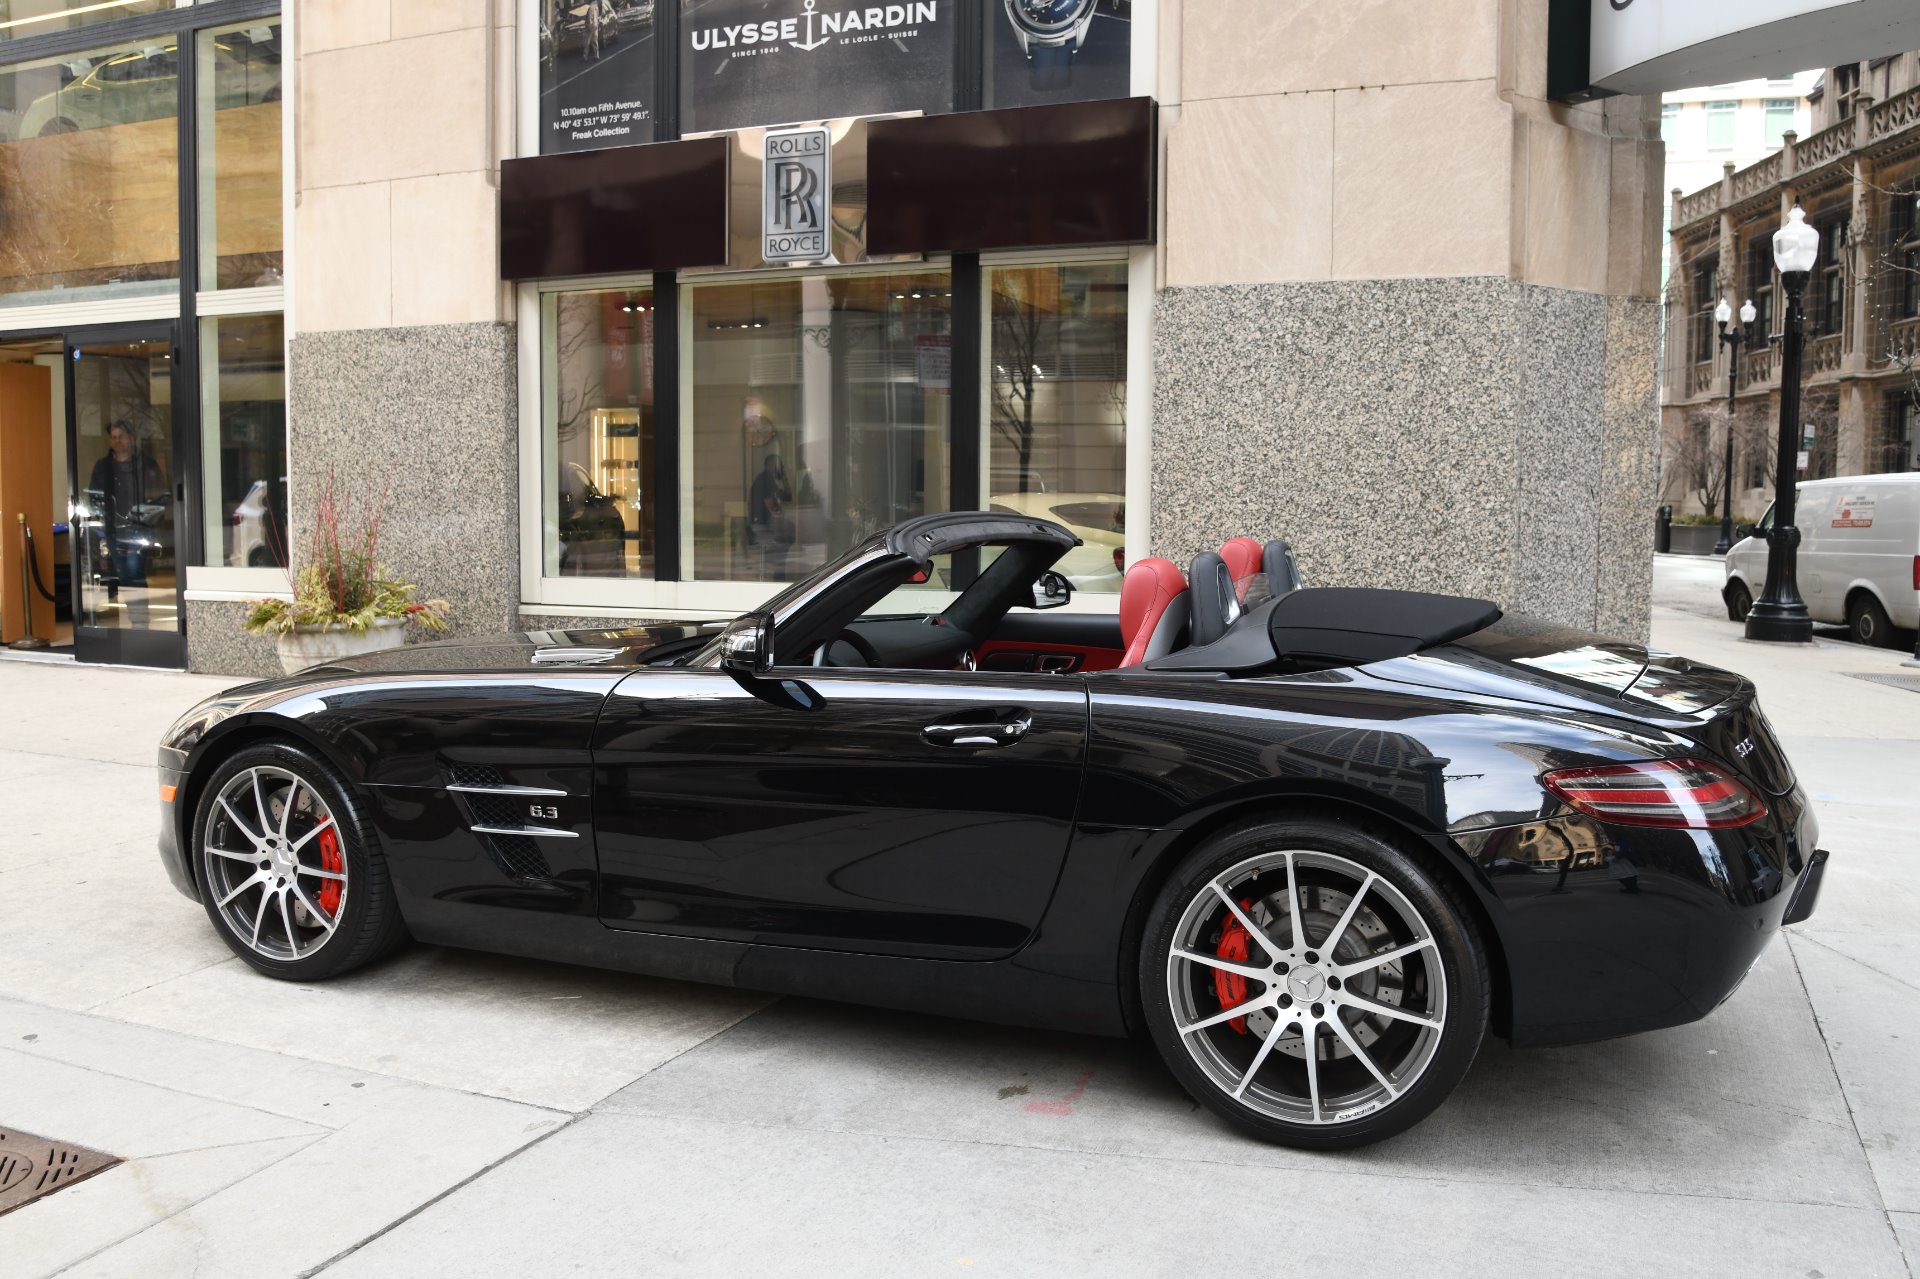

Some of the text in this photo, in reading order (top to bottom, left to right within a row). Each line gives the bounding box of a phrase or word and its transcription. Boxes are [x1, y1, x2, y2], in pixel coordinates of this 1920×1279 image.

[691, 0, 937, 51] ULYSSE NARDIN
[852, 34, 878, 43] LOCLE
[888, 29, 918, 39] SUISSE
[731, 46, 780, 58] SINCE 1846
[561, 100, 642, 117] 10.10am on Fifth Avenue.
[553, 121, 560, 130] N
[599, 116, 608, 124] W
[572, 126, 630, 140] Freak Collection
[770, 136, 821, 155] ROLLS
[773, 161, 818, 230] RR
[769, 236, 820, 253] ROYCE
[530, 805, 558, 819] 6.3
